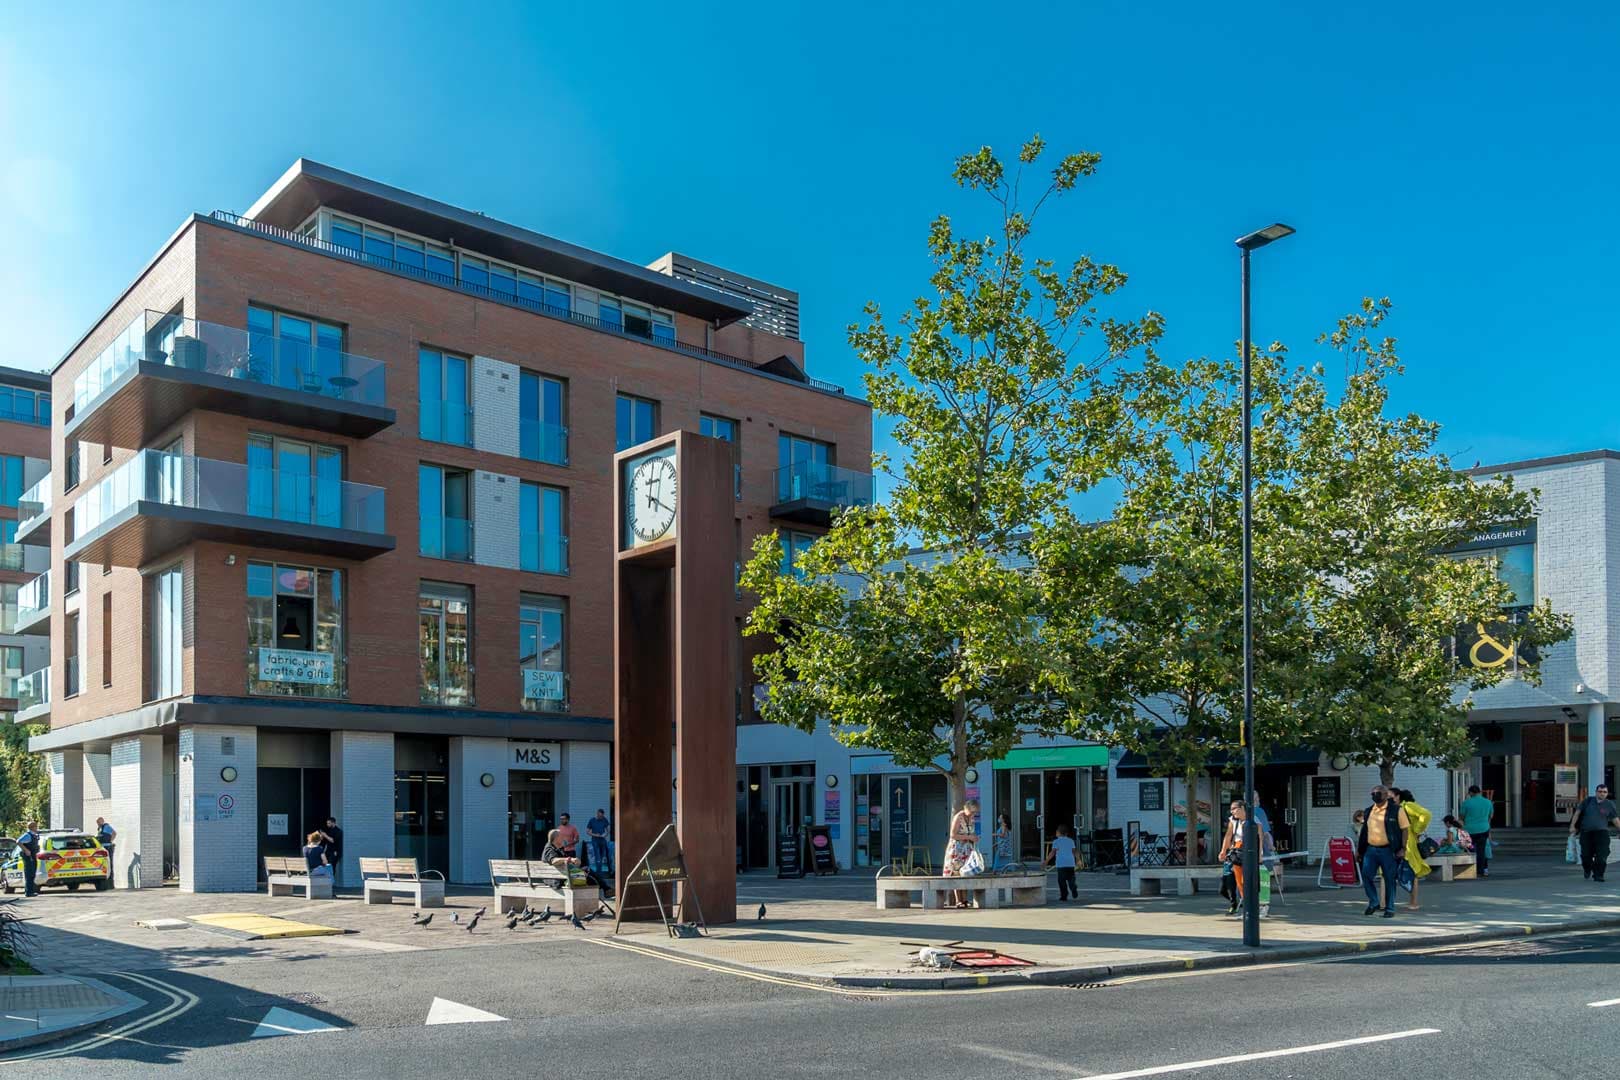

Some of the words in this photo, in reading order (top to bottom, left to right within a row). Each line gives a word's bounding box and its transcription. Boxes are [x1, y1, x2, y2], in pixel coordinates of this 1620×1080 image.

[1469, 530, 1527, 542] ANAGEMENT
[264, 667, 294, 676] crafts
[297, 668, 304, 677] &
[307, 669, 330, 679] gifts
[532, 672, 556, 682] SEW
[531, 688, 556, 697] KNIT
[515, 748, 551, 765] M&S
